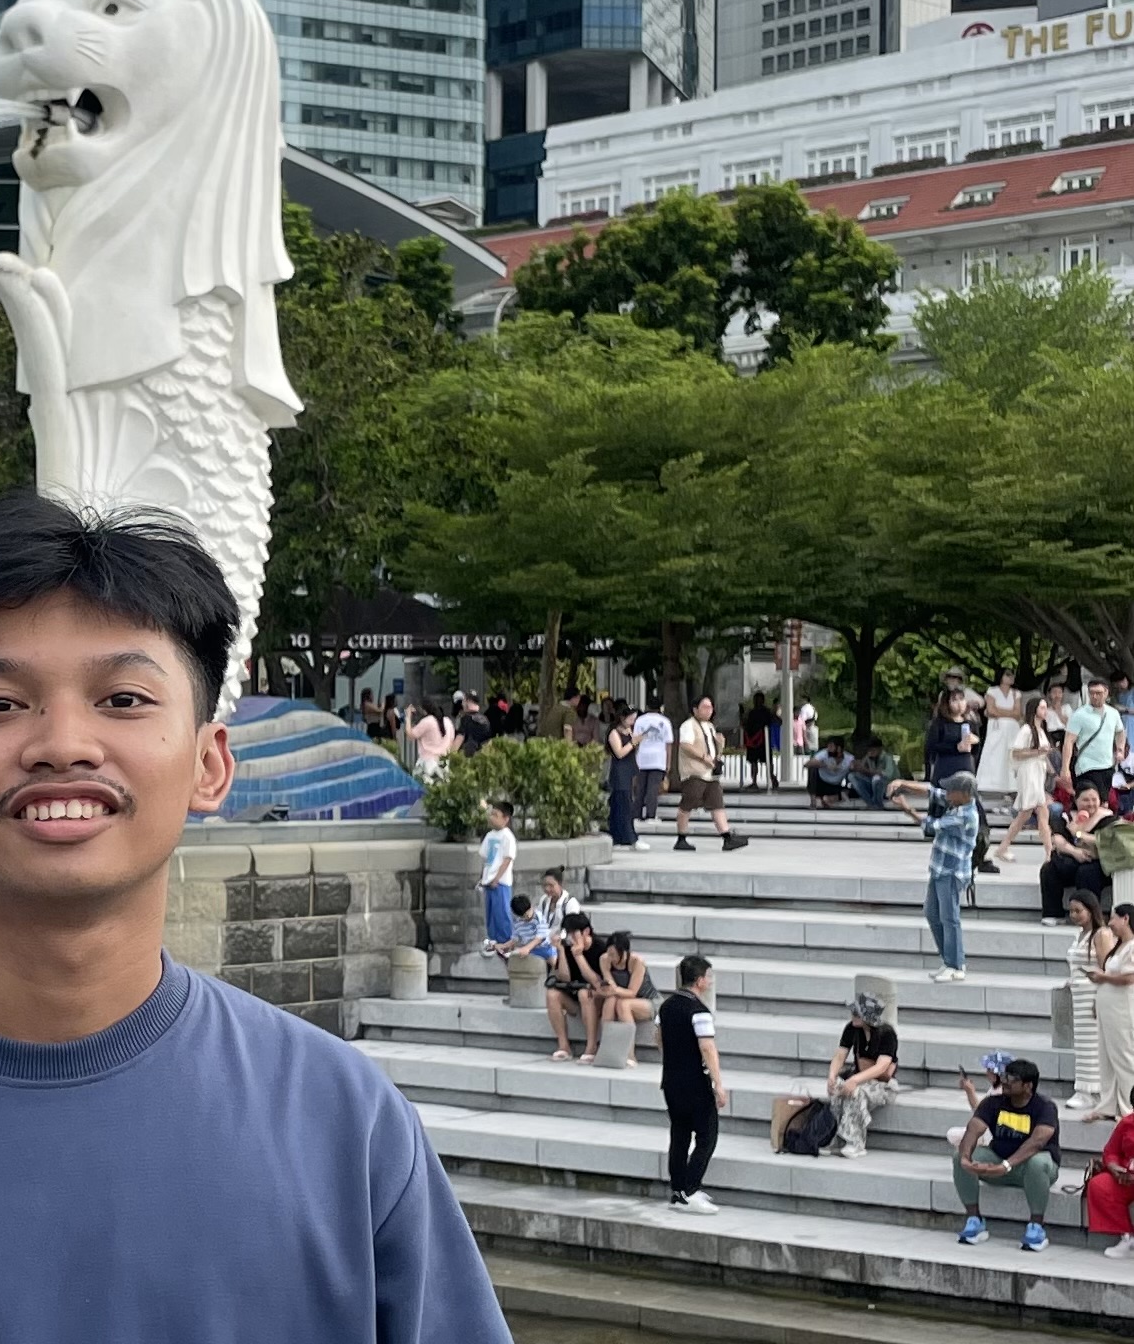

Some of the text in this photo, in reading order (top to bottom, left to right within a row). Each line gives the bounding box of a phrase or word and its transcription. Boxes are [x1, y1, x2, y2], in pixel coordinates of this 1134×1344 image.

[1000, 22, 1069, 60] THE
[347, 633, 413, 649] COFFEE
[438, 633, 506, 649] GELATO
